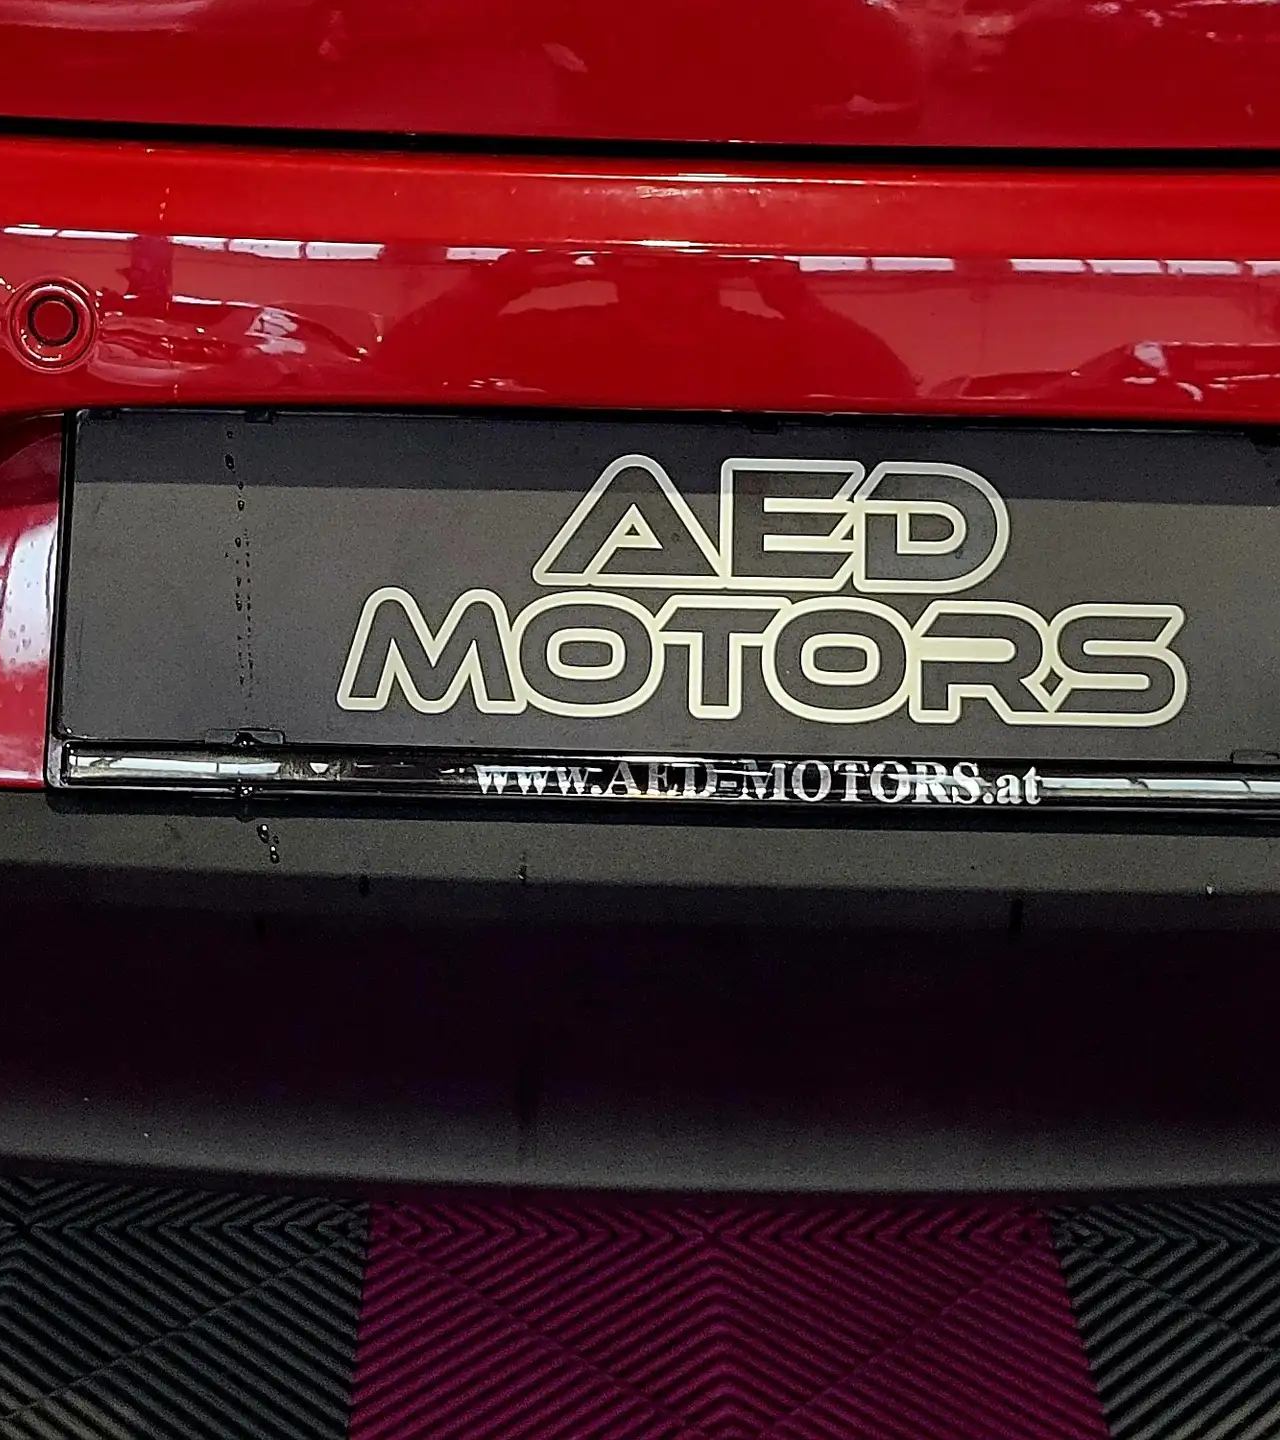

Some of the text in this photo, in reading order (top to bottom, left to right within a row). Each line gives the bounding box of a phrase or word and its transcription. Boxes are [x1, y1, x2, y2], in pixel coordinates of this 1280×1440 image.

[532, 453, 1011, 594] AED
[336, 586, 1191, 727] MOTORS
[474, 758, 1043, 805] www.AED-MOTORS.at
